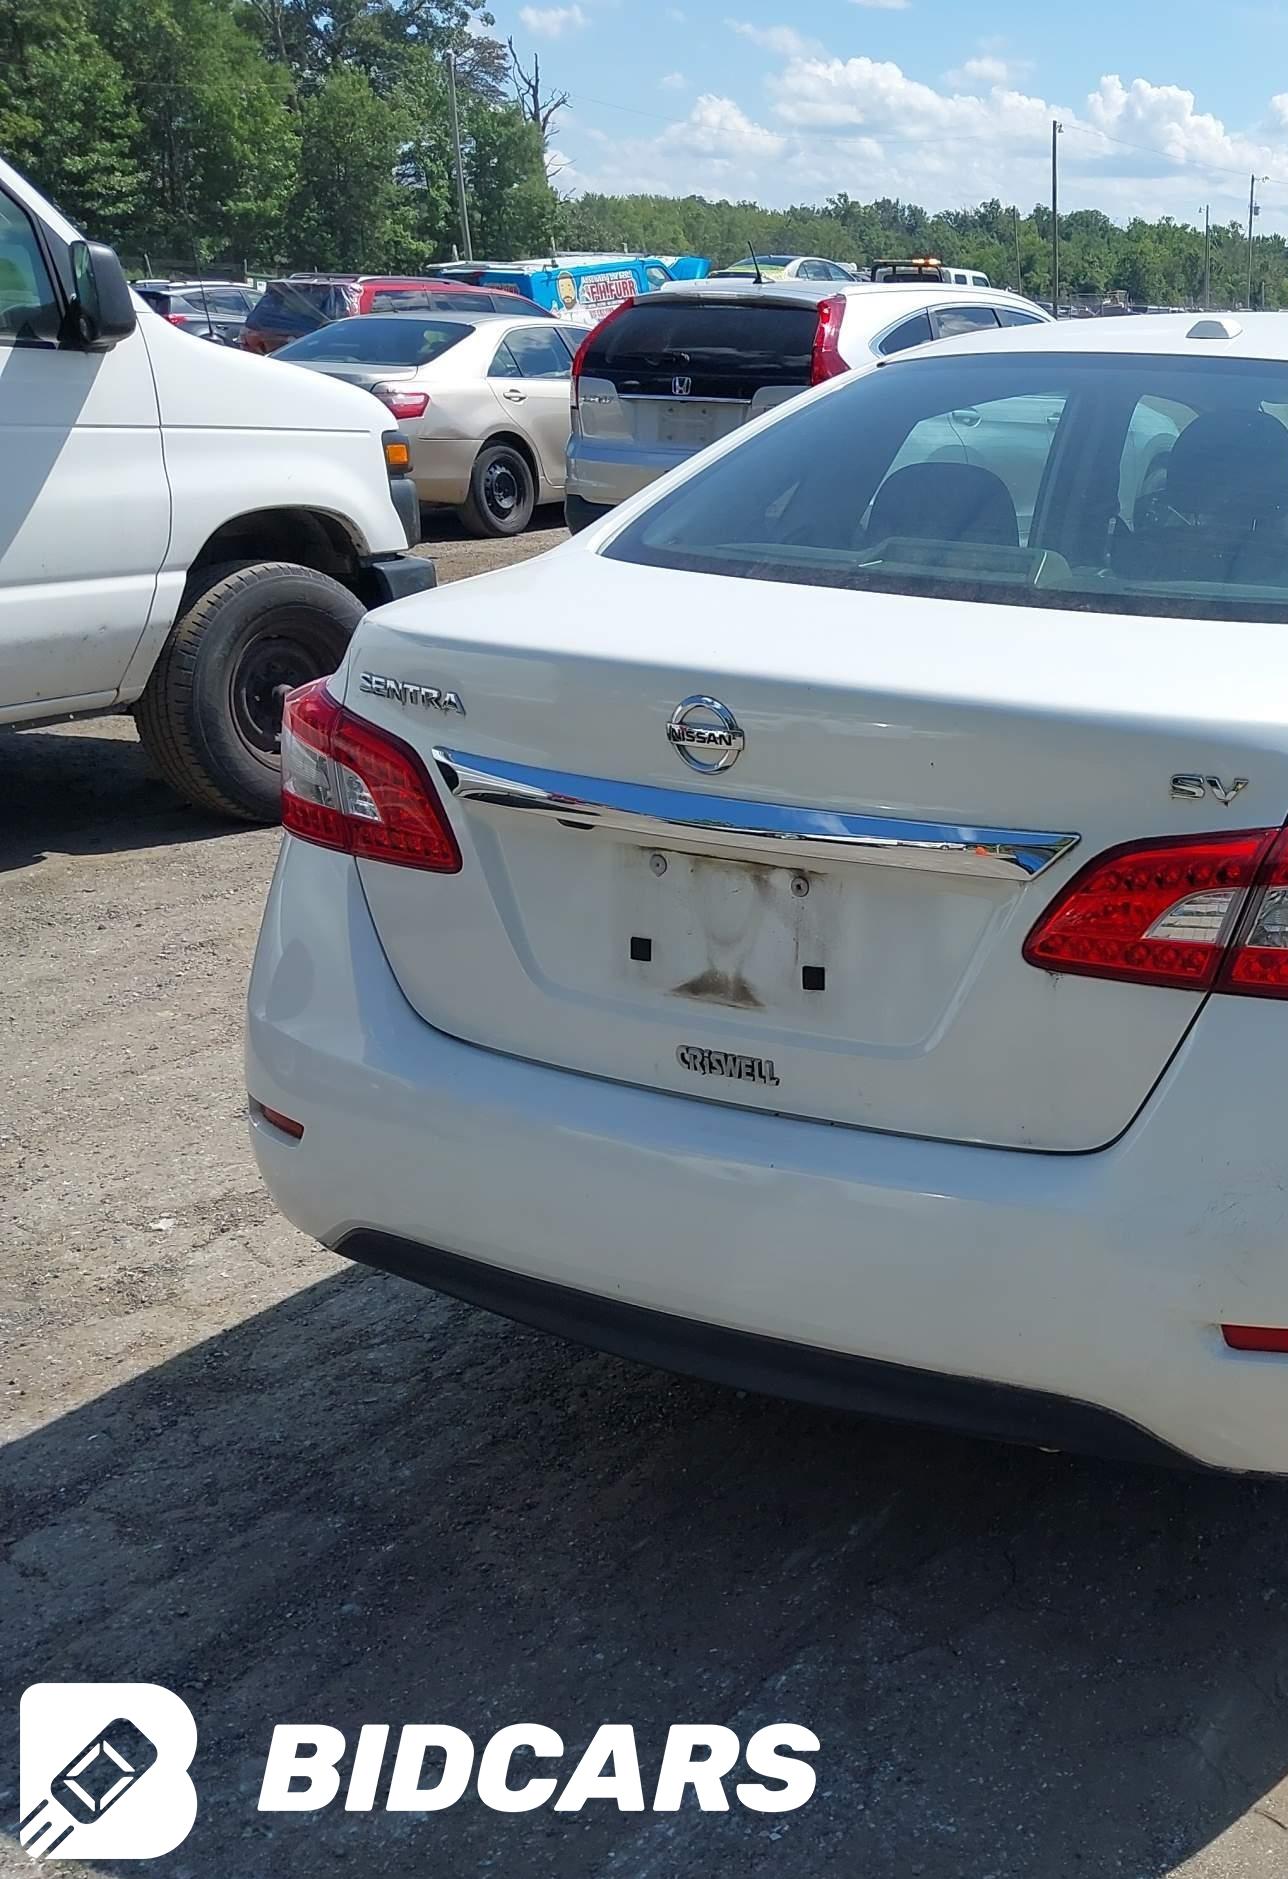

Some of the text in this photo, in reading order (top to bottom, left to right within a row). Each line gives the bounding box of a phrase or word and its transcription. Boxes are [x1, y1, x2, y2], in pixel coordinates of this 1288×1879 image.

[360, 671, 466, 716] SENTRA
[671, 727, 733, 746] NISSAN
[1170, 774, 1249, 807] SV
